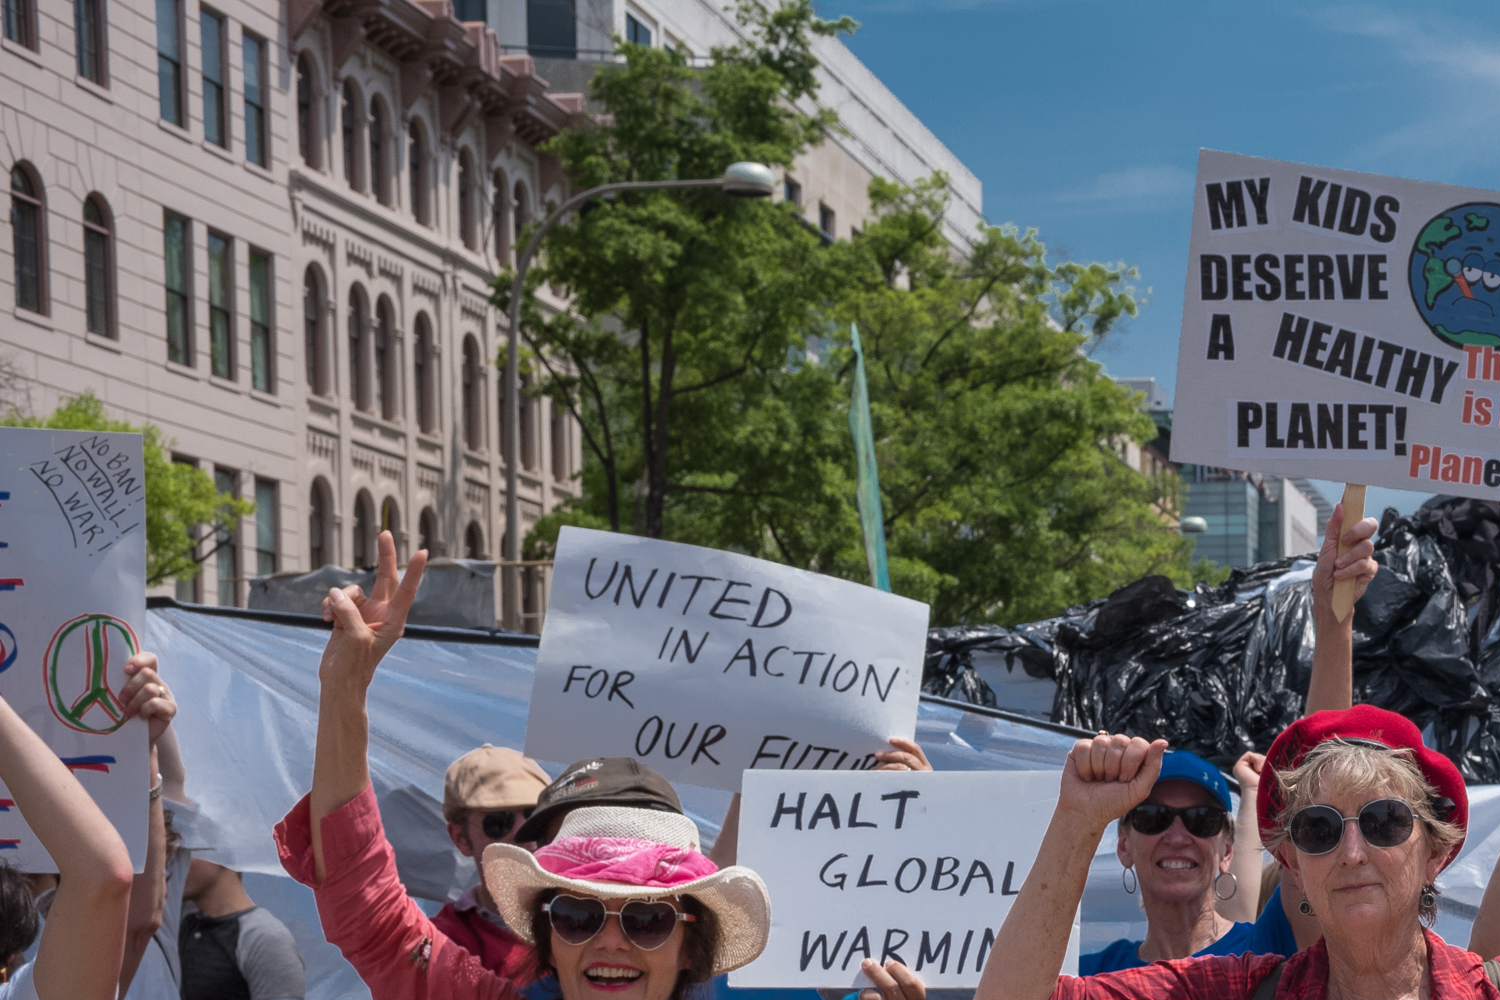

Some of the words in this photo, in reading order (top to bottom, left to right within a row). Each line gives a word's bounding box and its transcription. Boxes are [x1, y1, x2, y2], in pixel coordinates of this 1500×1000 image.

[1205, 177, 1270, 231] MY
[1292, 176, 1400, 243] KIDS
[1201, 253, 1389, 301] DESERVE
[1207, 314, 1235, 361] A
[1272, 313, 1460, 405] HEALTHY
[1237, 401, 1408, 457] PLANET!
[1462, 390, 1492, 426] is
[54, 445, 87, 471] NO
[87, 471, 139, 539] WALL!
[80, 435, 109, 456] NO
[107, 452, 144, 506] BAN!
[30, 461, 64, 487] NO
[64, 491, 113, 557] WAR!
[583, 557, 792, 629] UNITED
[563, 664, 636, 709] FOR
[657, 626, 710, 664] IN
[724, 639, 900, 703] ACTION
[635, 715, 727, 765] OUR
[770, 790, 920, 831] HALT
[818, 853, 1020, 897] GLOBAL
